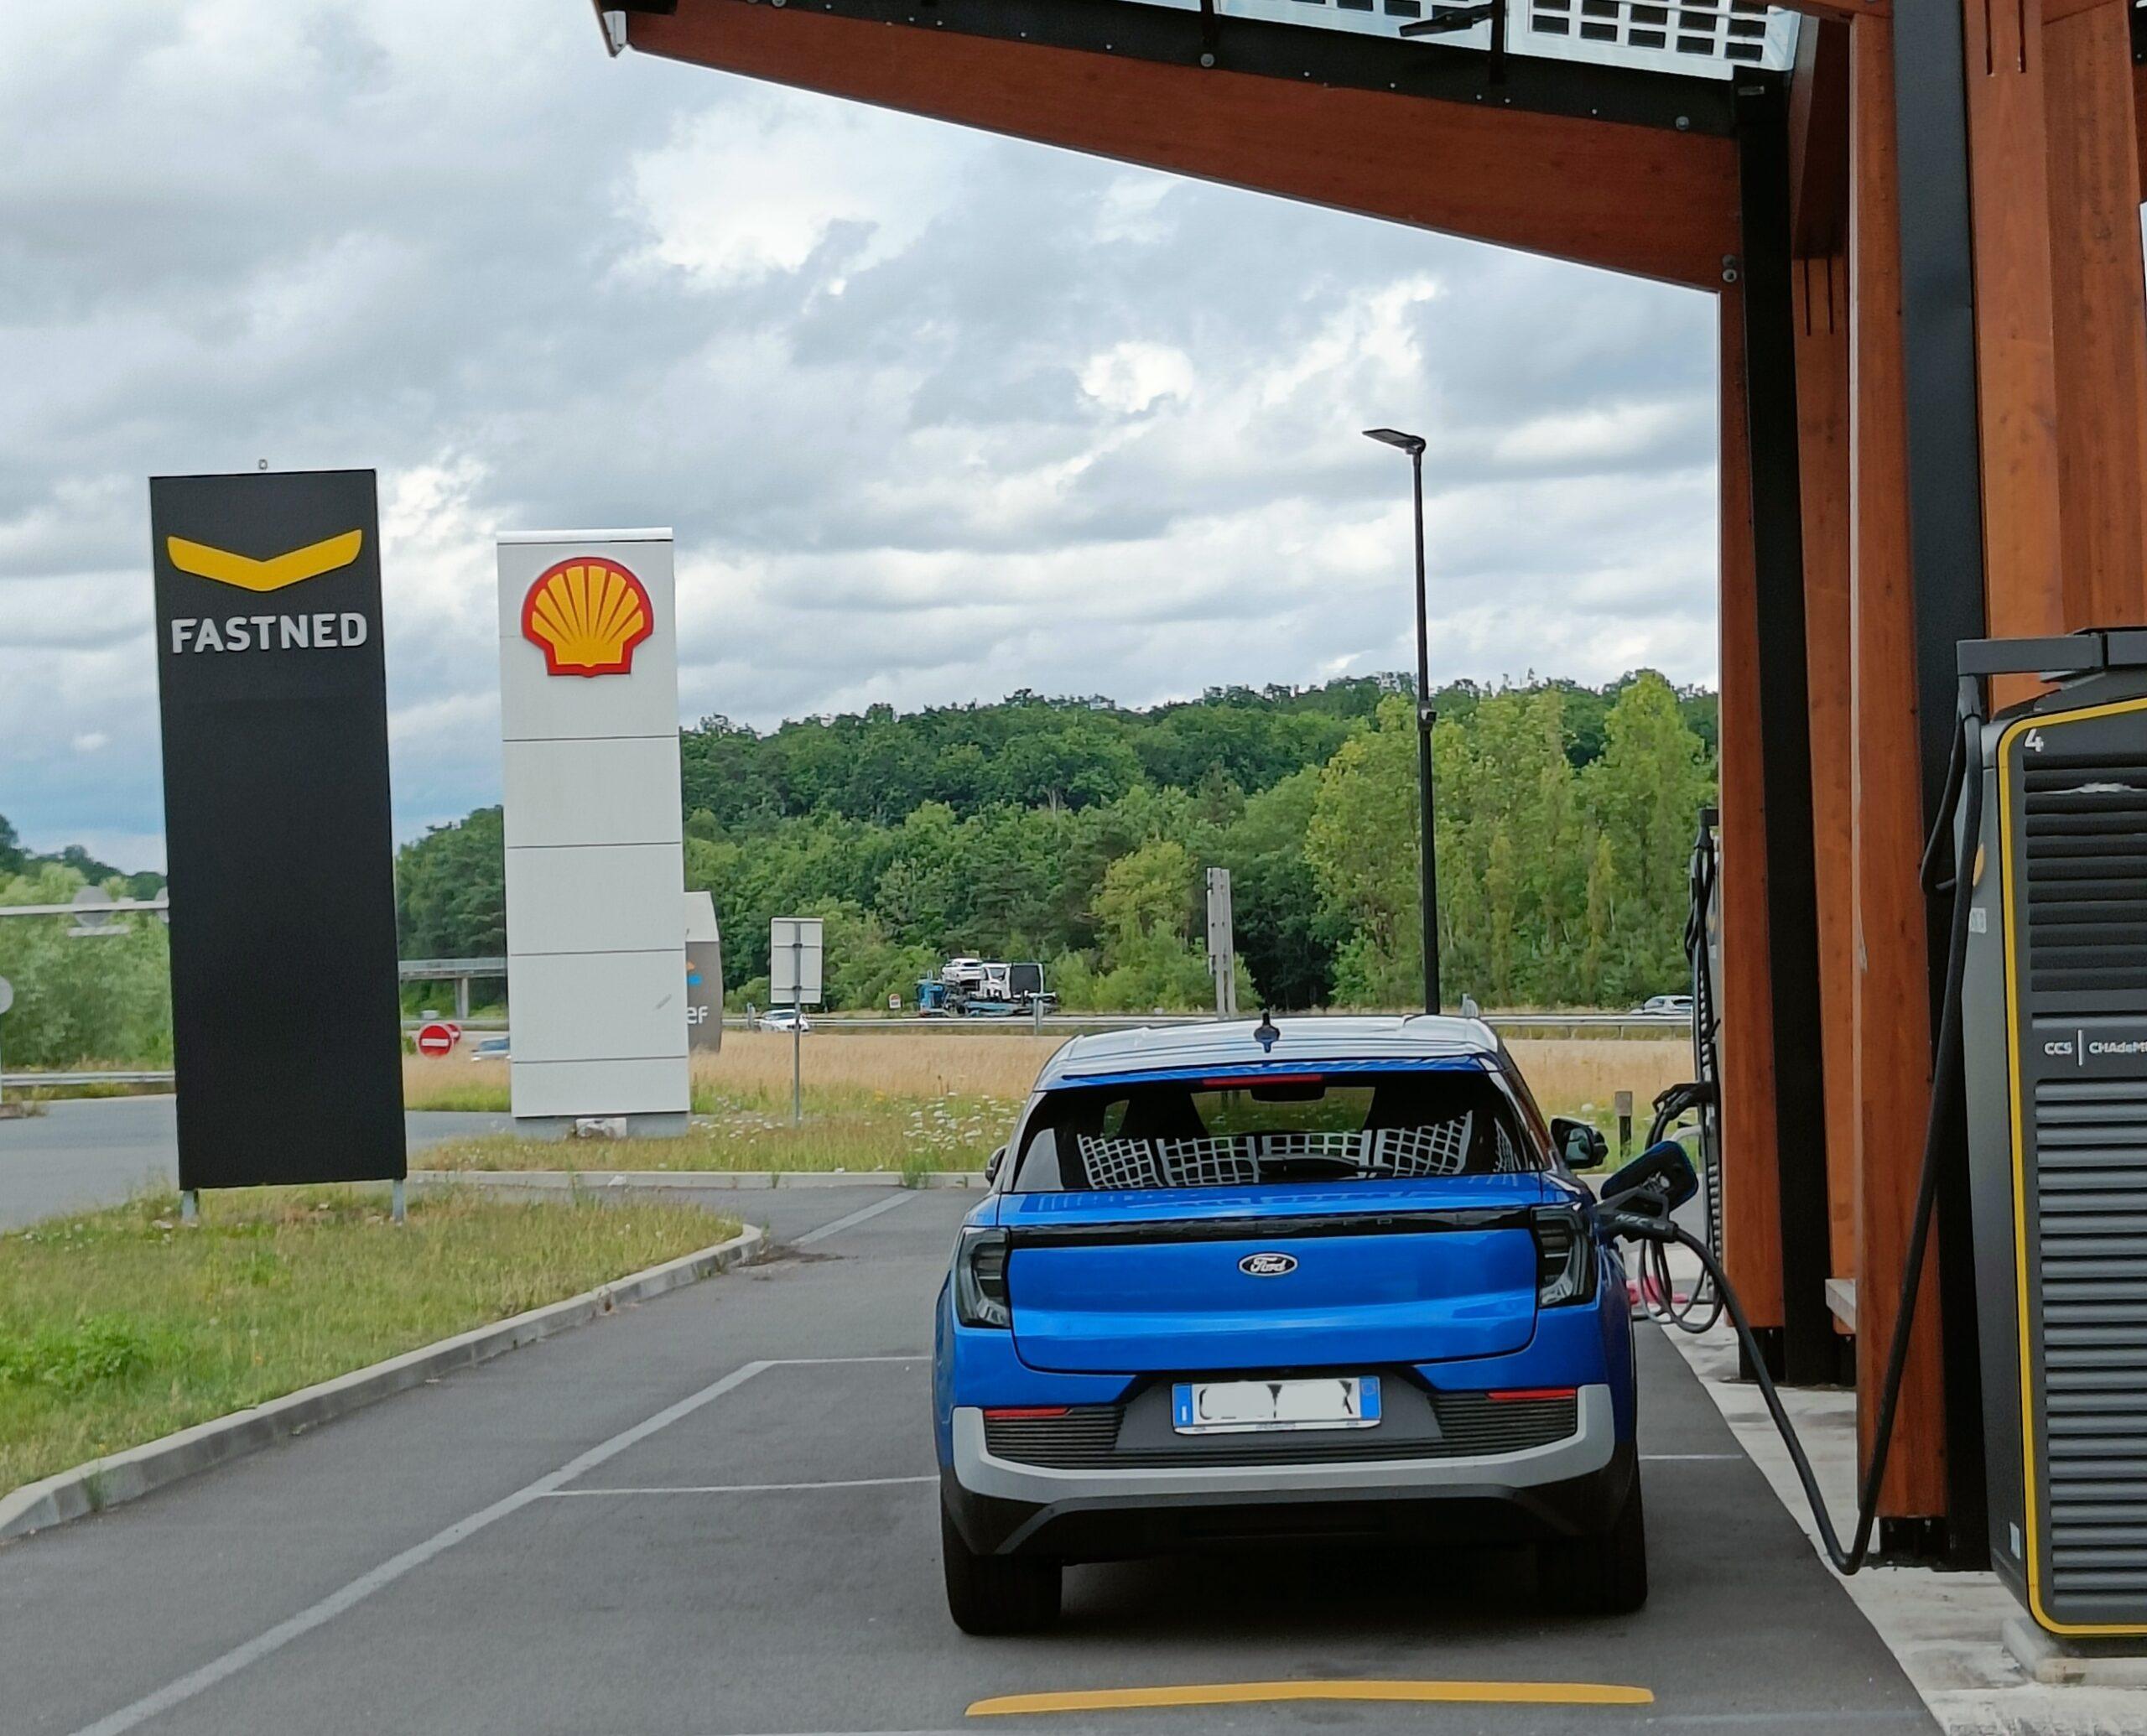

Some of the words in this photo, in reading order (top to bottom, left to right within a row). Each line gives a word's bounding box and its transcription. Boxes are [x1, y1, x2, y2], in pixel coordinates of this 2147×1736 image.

[171, 612, 367, 653] FASTNED
[2024, 728, 2045, 752] 4
[2044, 1042, 2072, 1055] CCS
[1250, 1257, 1287, 1272] Ford
